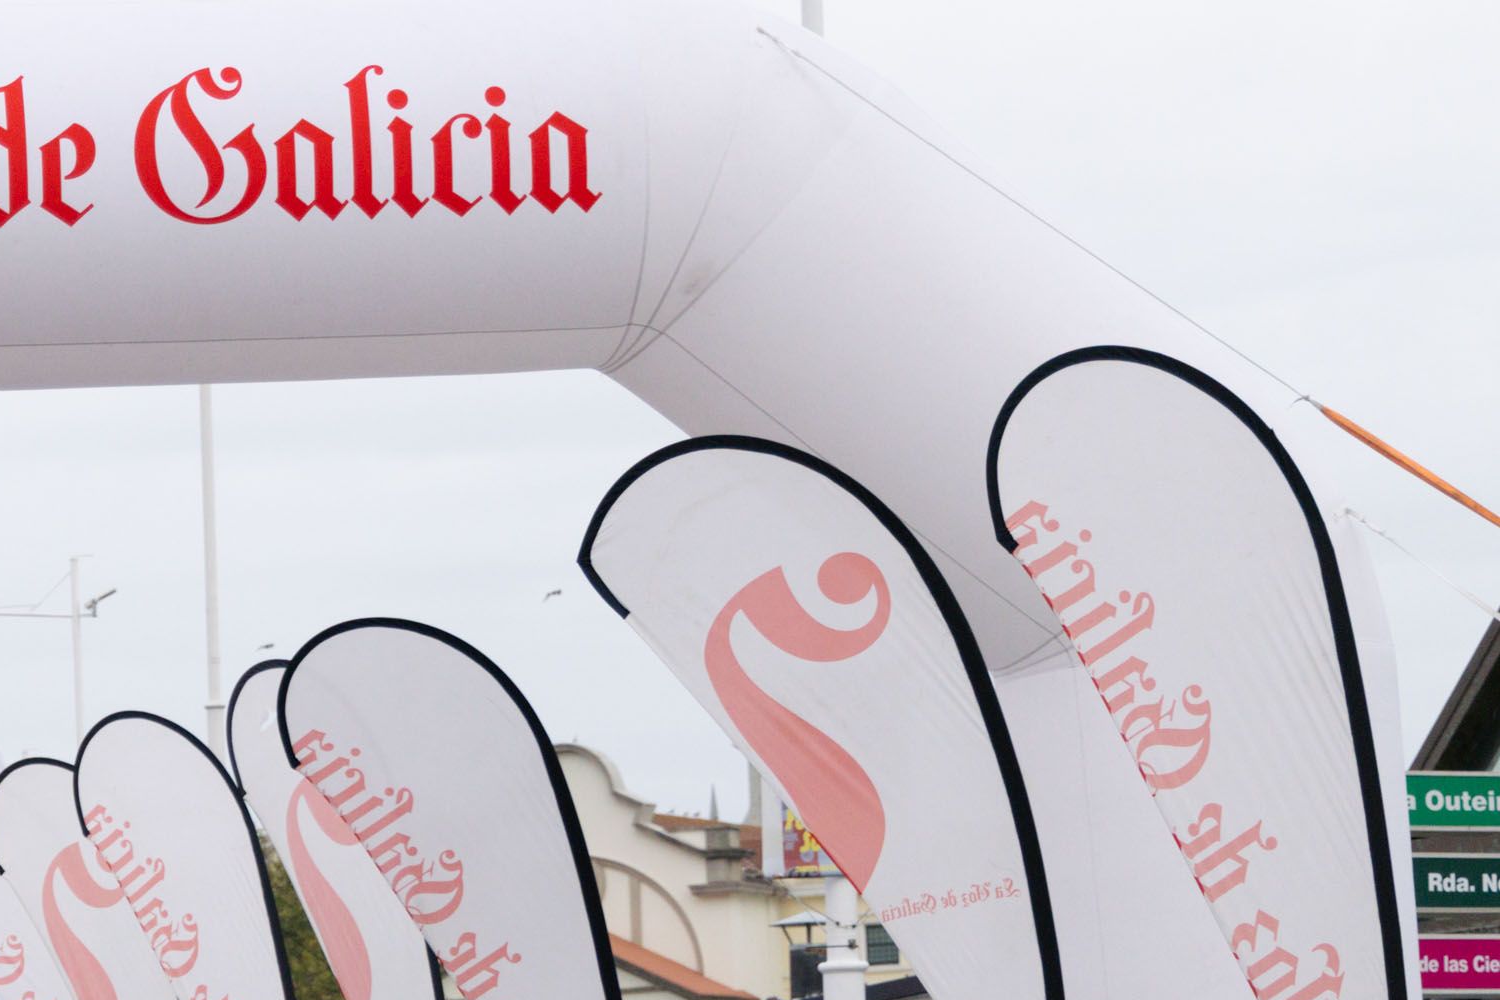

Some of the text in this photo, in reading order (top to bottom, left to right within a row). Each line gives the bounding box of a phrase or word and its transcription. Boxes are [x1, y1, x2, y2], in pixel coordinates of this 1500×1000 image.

[134, 65, 602, 224] Galicia
[1428, 873, 1475, 892] Rda.
[1444, 955, 1468, 973] las
